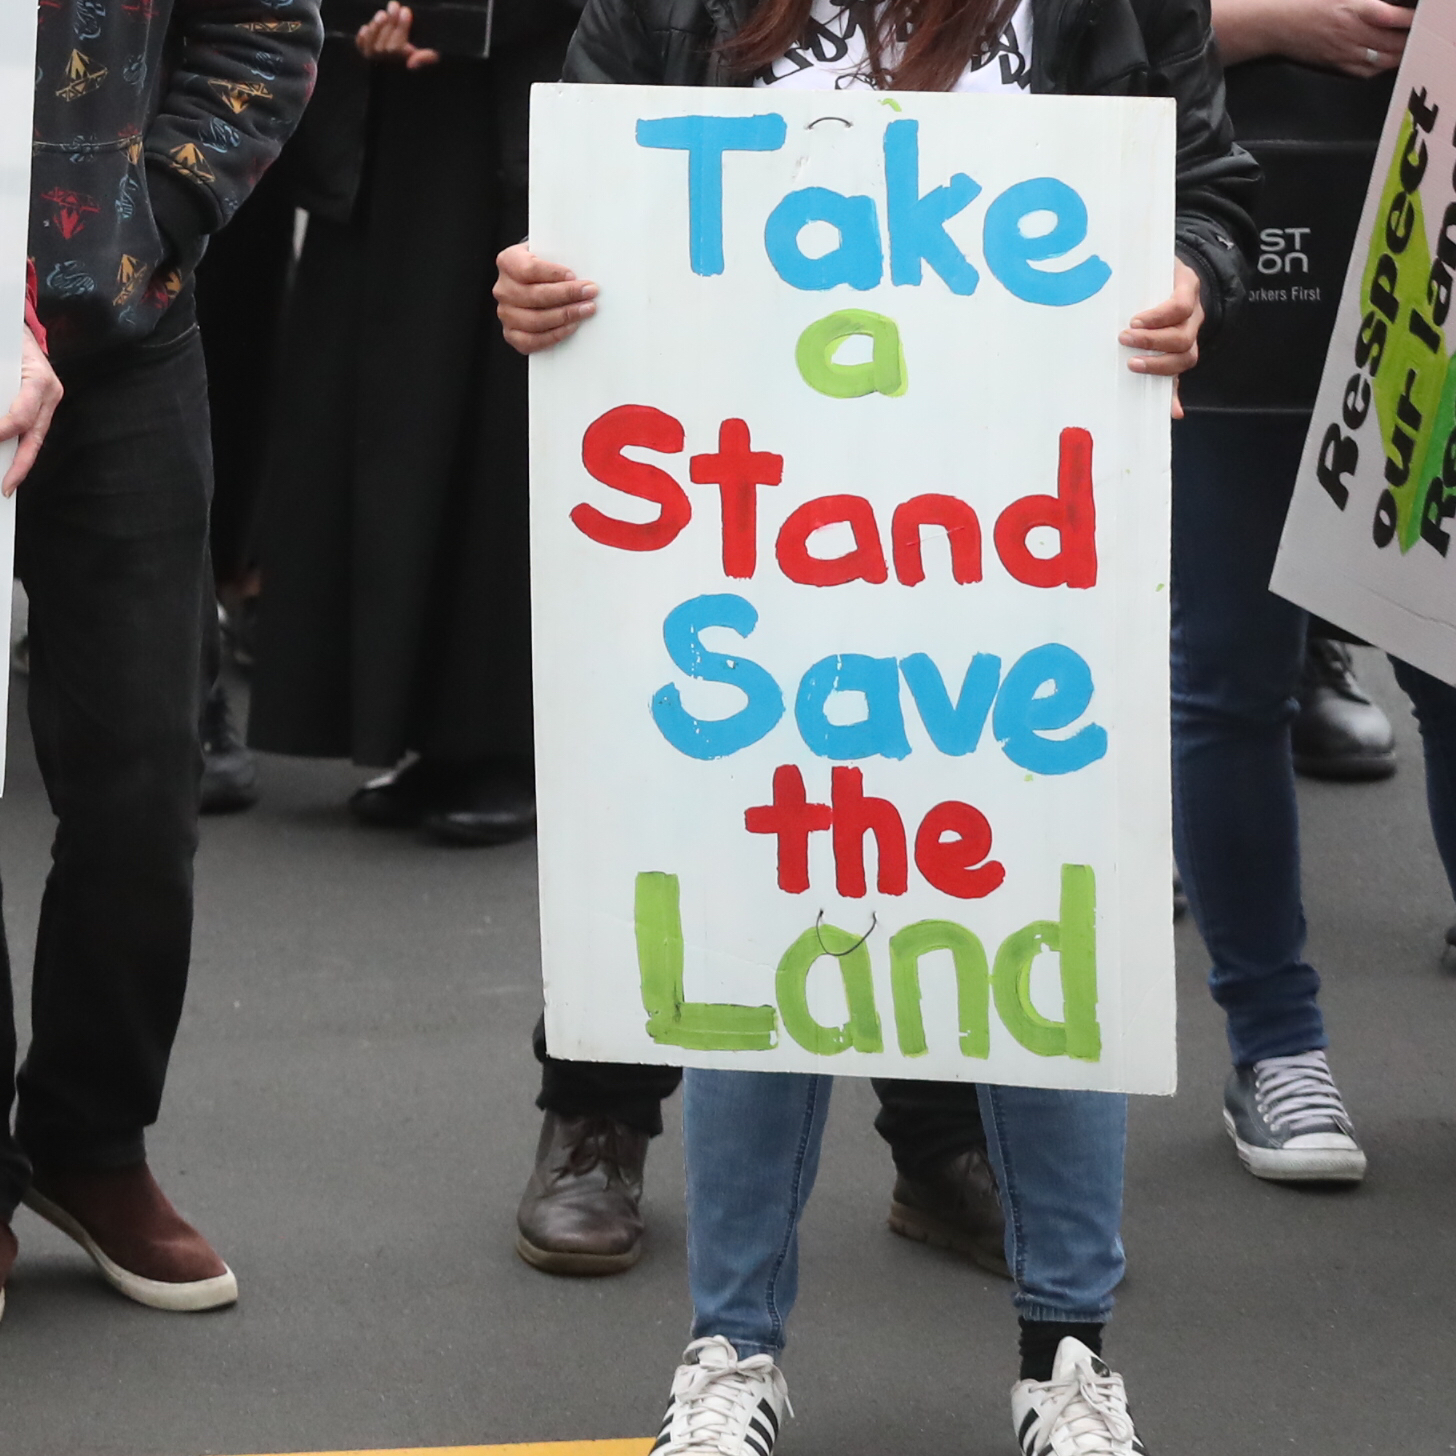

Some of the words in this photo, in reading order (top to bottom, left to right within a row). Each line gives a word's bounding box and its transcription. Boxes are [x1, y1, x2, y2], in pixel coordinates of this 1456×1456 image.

[635, 112, 1112, 307] Take
[1316, 86, 1440, 511] Respect
[795, 308, 908, 399] a
[569, 403, 1097, 588] Stand
[649, 593, 1108, 775] Save
[744, 763, 1006, 900] the
[634, 863, 1102, 1062] Land
